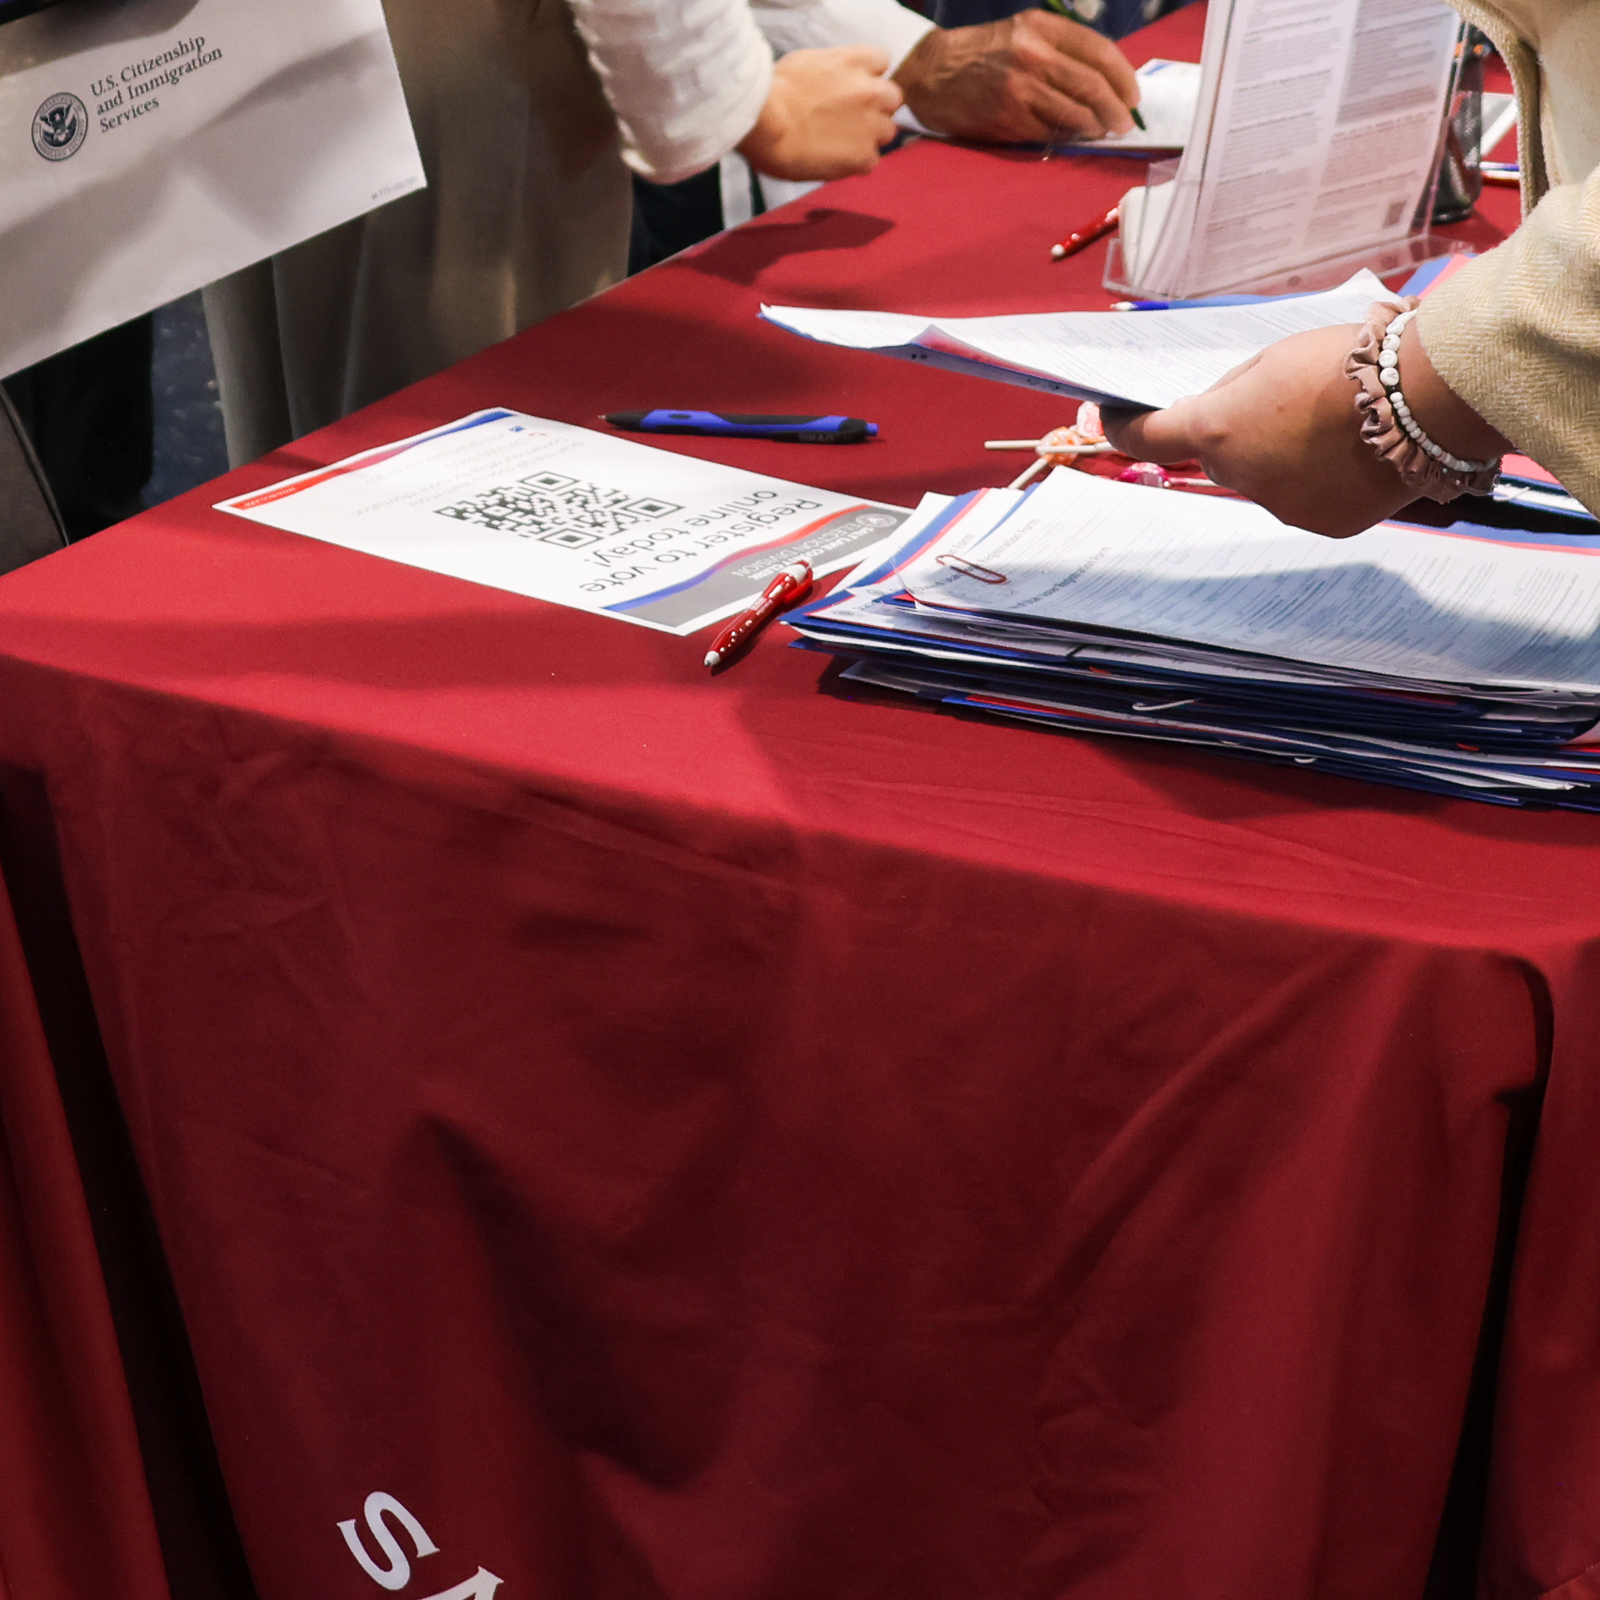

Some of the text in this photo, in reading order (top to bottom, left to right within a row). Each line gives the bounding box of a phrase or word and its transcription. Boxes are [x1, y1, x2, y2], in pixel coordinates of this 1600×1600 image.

[90, 36, 205, 96] U.S. Citizenship
[97, 48, 223, 115] and Immigration
[100, 97, 160, 133] Services
[579, 498, 824, 592] Register to vote
[583, 490, 778, 569] online today!
